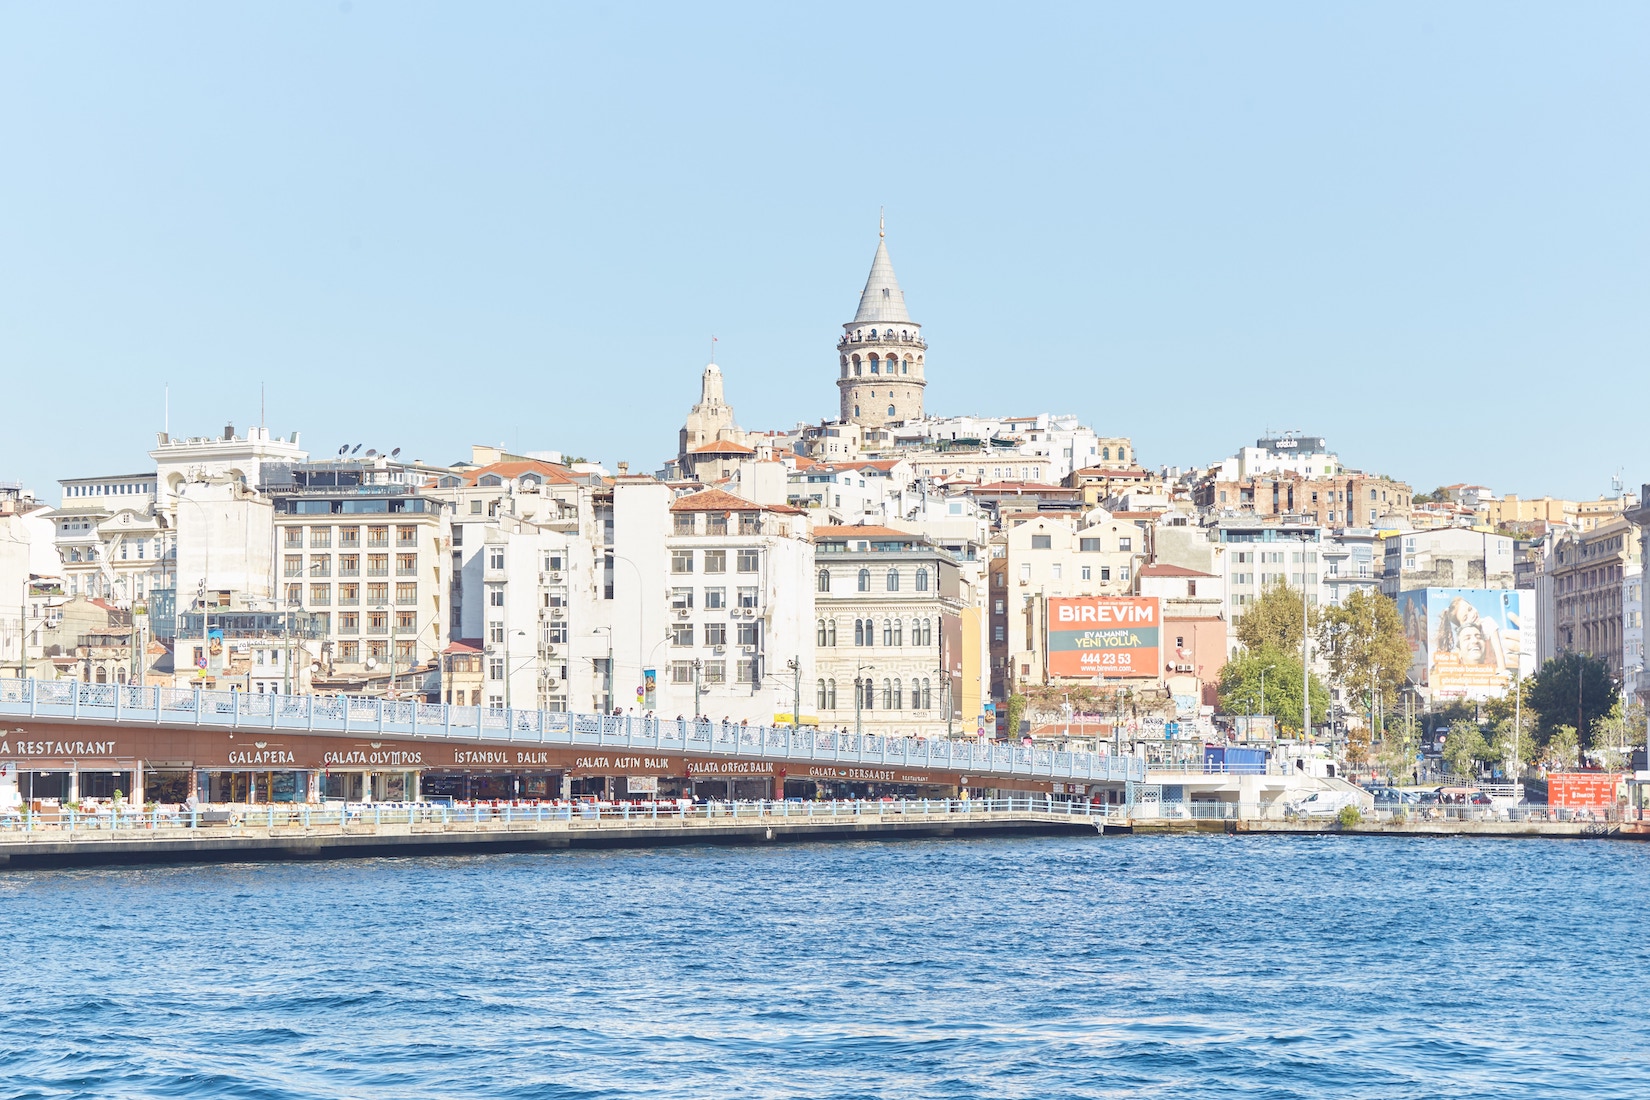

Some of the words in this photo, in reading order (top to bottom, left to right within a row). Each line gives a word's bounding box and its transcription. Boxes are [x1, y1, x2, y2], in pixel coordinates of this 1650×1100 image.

[1095, 630, 1128, 638] ALMANIN
[1080, 653, 1100, 664] 444
[1102, 653, 1116, 664] 23
[1118, 653, 1131, 664] 53
[17, 741, 116, 754] RESTAURANT
[228, 751, 295, 764] GALAPERA
[324, 751, 366, 764] GALATA
[369, 751, 422, 765] OLYMPOS
[454, 748, 508, 763] İSTANBUL
[517, 752, 548, 763] BALIK
[576, 757, 609, 768] GALATA
[614, 757, 640, 768] ALTIN
[644, 758, 669, 769] BALIK
[687, 762, 718, 773] GALATA
[721, 762, 748, 773] ORFOZ
[750, 762, 774, 773] BALIK
[809, 767, 837, 777] GALATA
[849, 768, 895, 780] DERSAADET
